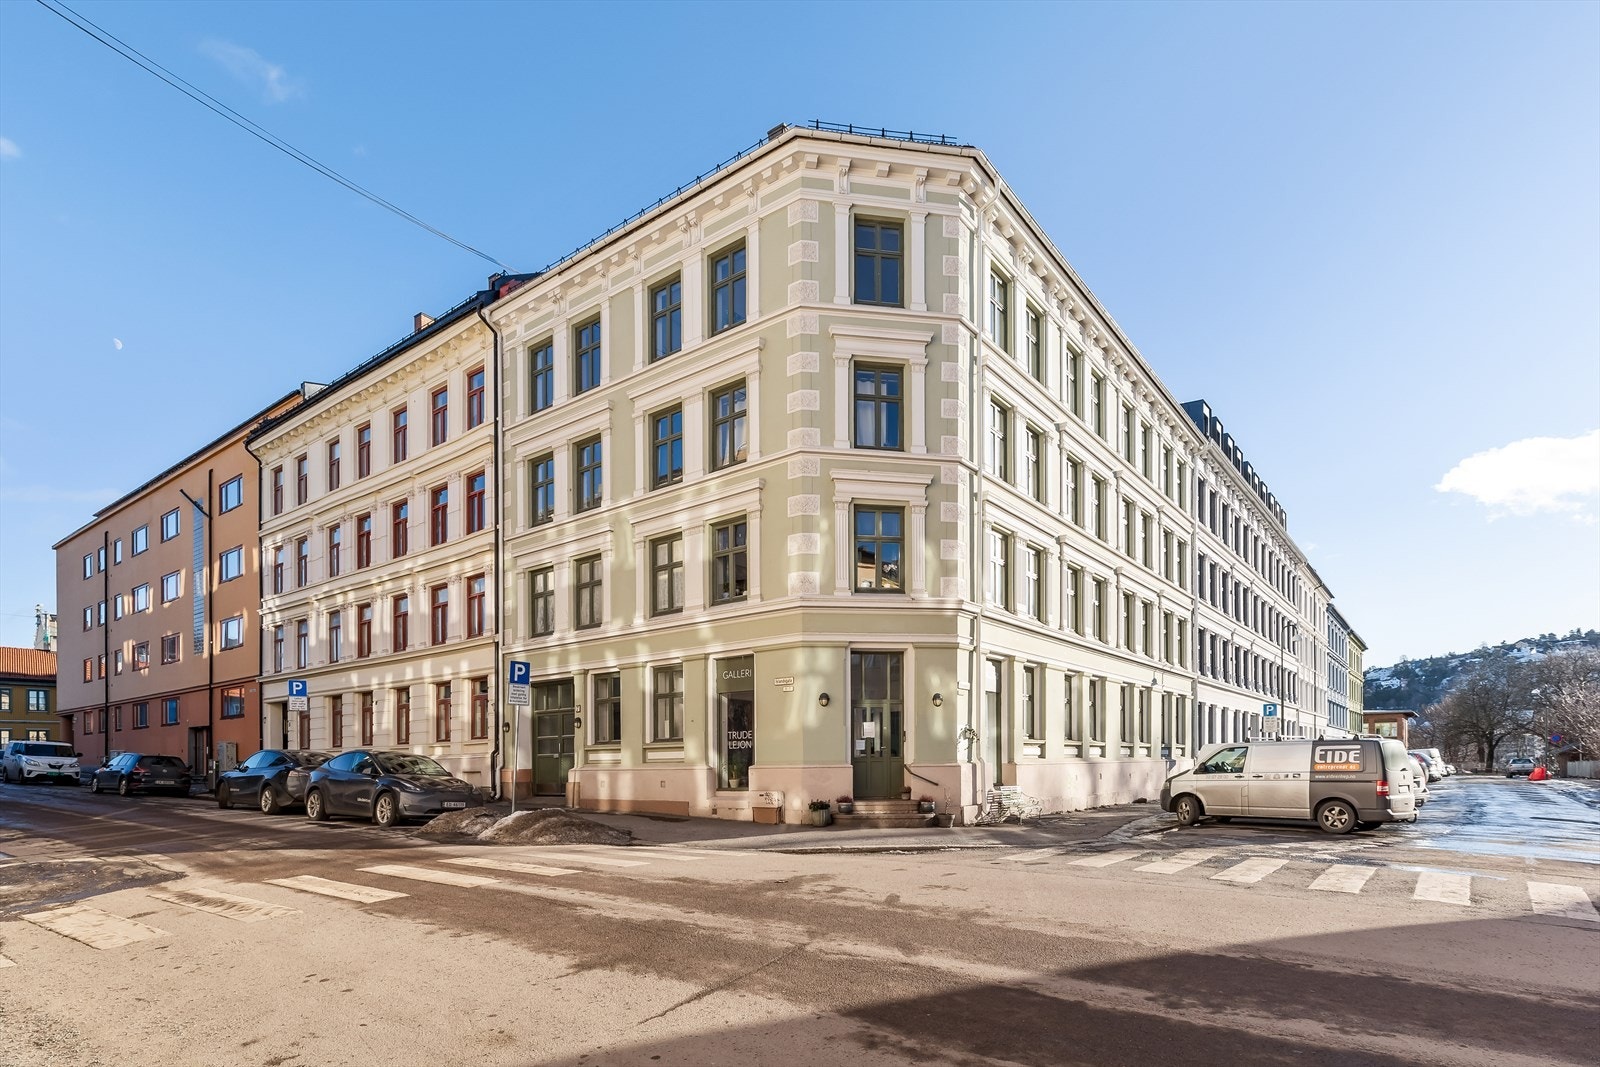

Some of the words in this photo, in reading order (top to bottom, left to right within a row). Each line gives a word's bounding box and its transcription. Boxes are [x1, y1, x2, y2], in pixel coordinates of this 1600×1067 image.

[514, 663, 526, 682] P
[722, 669, 752, 680] GALLERI
[292, 681, 303, 695] P
[1266, 705, 1274, 715] P
[727, 730, 753, 740] TRUDE
[728, 740, 752, 750] LEJON
[1314, 744, 1361, 764] EIDE
